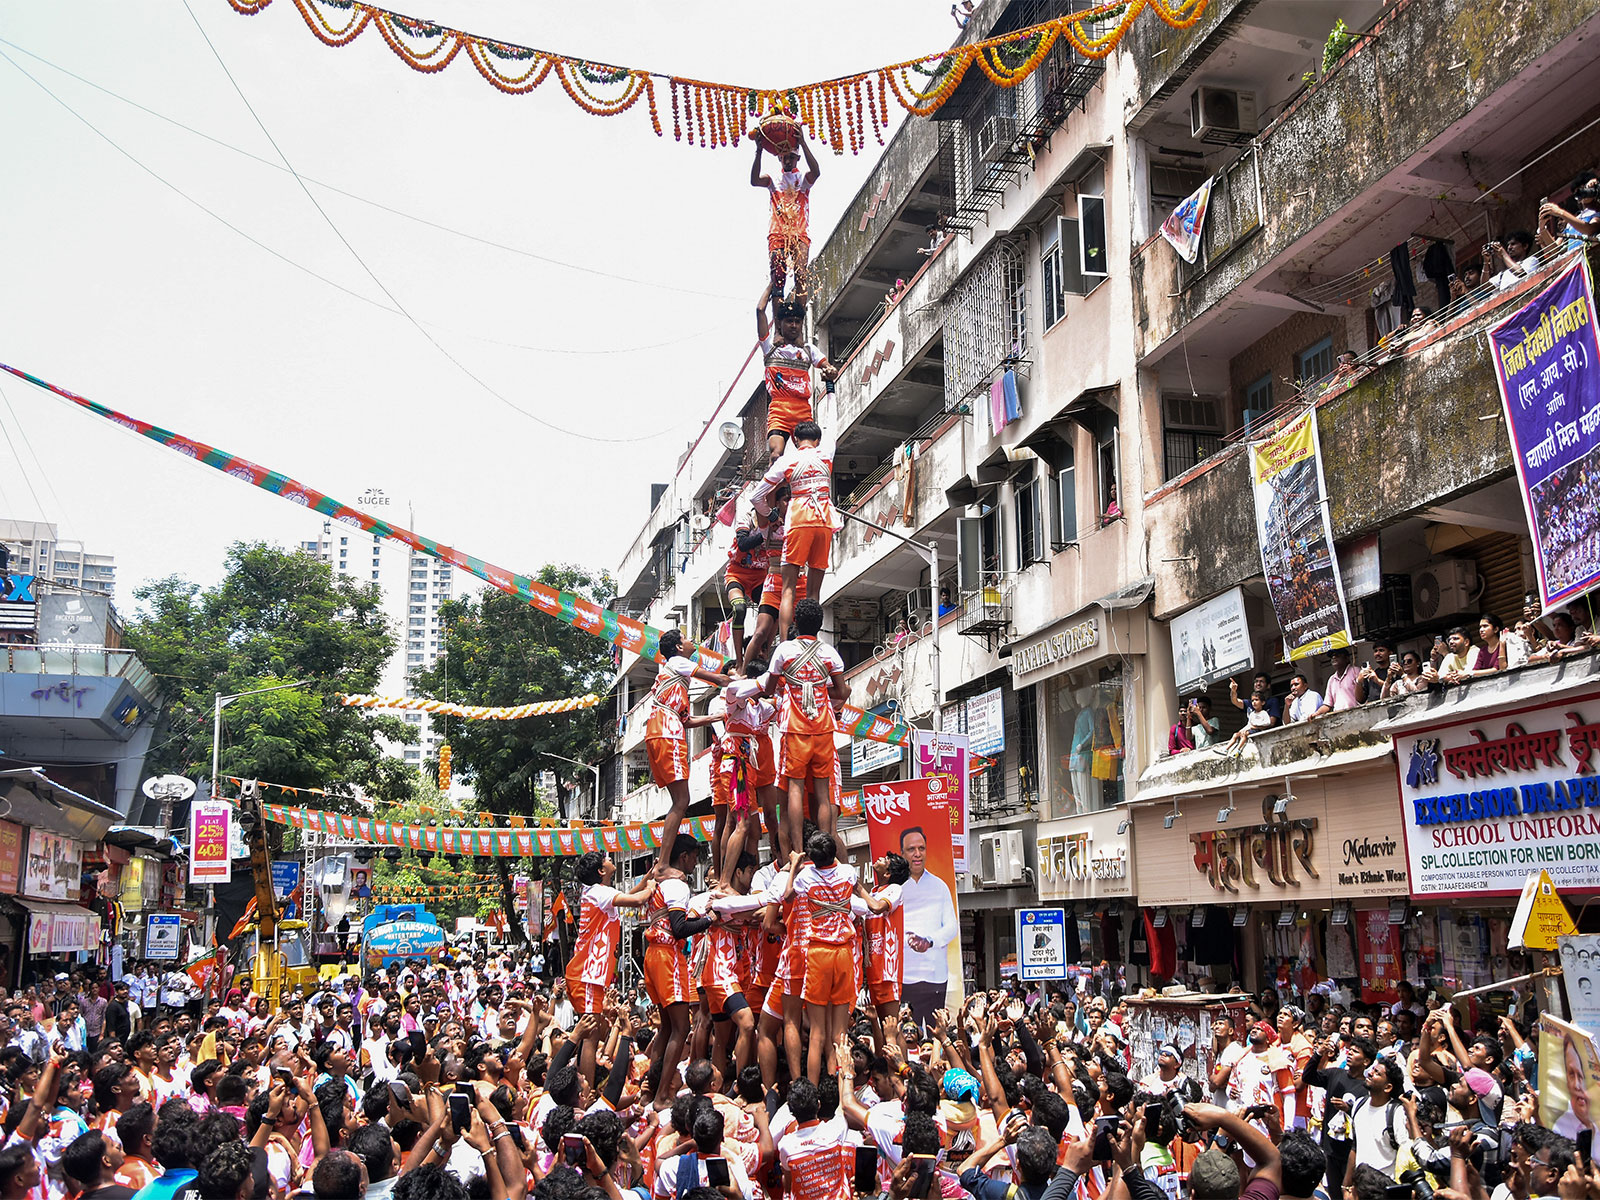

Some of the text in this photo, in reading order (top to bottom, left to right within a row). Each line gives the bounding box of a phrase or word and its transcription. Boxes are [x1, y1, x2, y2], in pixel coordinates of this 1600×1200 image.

[1500, 296, 1589, 380] जिवा देवशी निवास
[1540, 360, 1563, 390] आय.
[1545, 392, 1566, 416] आणि
[1525, 428, 1557, 470] व्यापारी
[1554, 420, 1580, 452] मित्र
[357, 497, 391, 505] SUGEE
[1013, 618, 1098, 676] JANATA STORES
[933, 763, 953, 771] FAT
[864, 785, 911, 825] साहेब
[926, 792, 948, 801] भाजपा
[1413, 774, 1600, 826] EXCELSIOR DRAPE
[1189, 794, 1320, 894] महावीर
[1432, 822, 1505, 849] SCHOOL
[1037, 830, 1094, 883] जनता
[1342, 835, 1397, 866] Mahavir
[1421, 849, 1508, 870] SPL.COLLECTION
[1511, 847, 1534, 864] FOR
[1537, 845, 1564, 862] NEW
[1338, 868, 1407, 885] Men's Ethnic Wear
[1421, 873, 1456, 882] COMPOSITION
[1456, 870, 1481, 880] TAXABLE
[1481, 869, 1504, 878] PERSON
[1505, 869, 1517, 877] NOT
[1546, 867, 1555, 875] TO
[1556, 865, 1585, 875] COLLECT
[1586, 865, 1599, 874] TAX
[1421, 883, 1437, 892] GSTIN:
[396, 922, 440, 936] TRANSPORT
[1537, 912, 1563, 921] पाण्याचा
